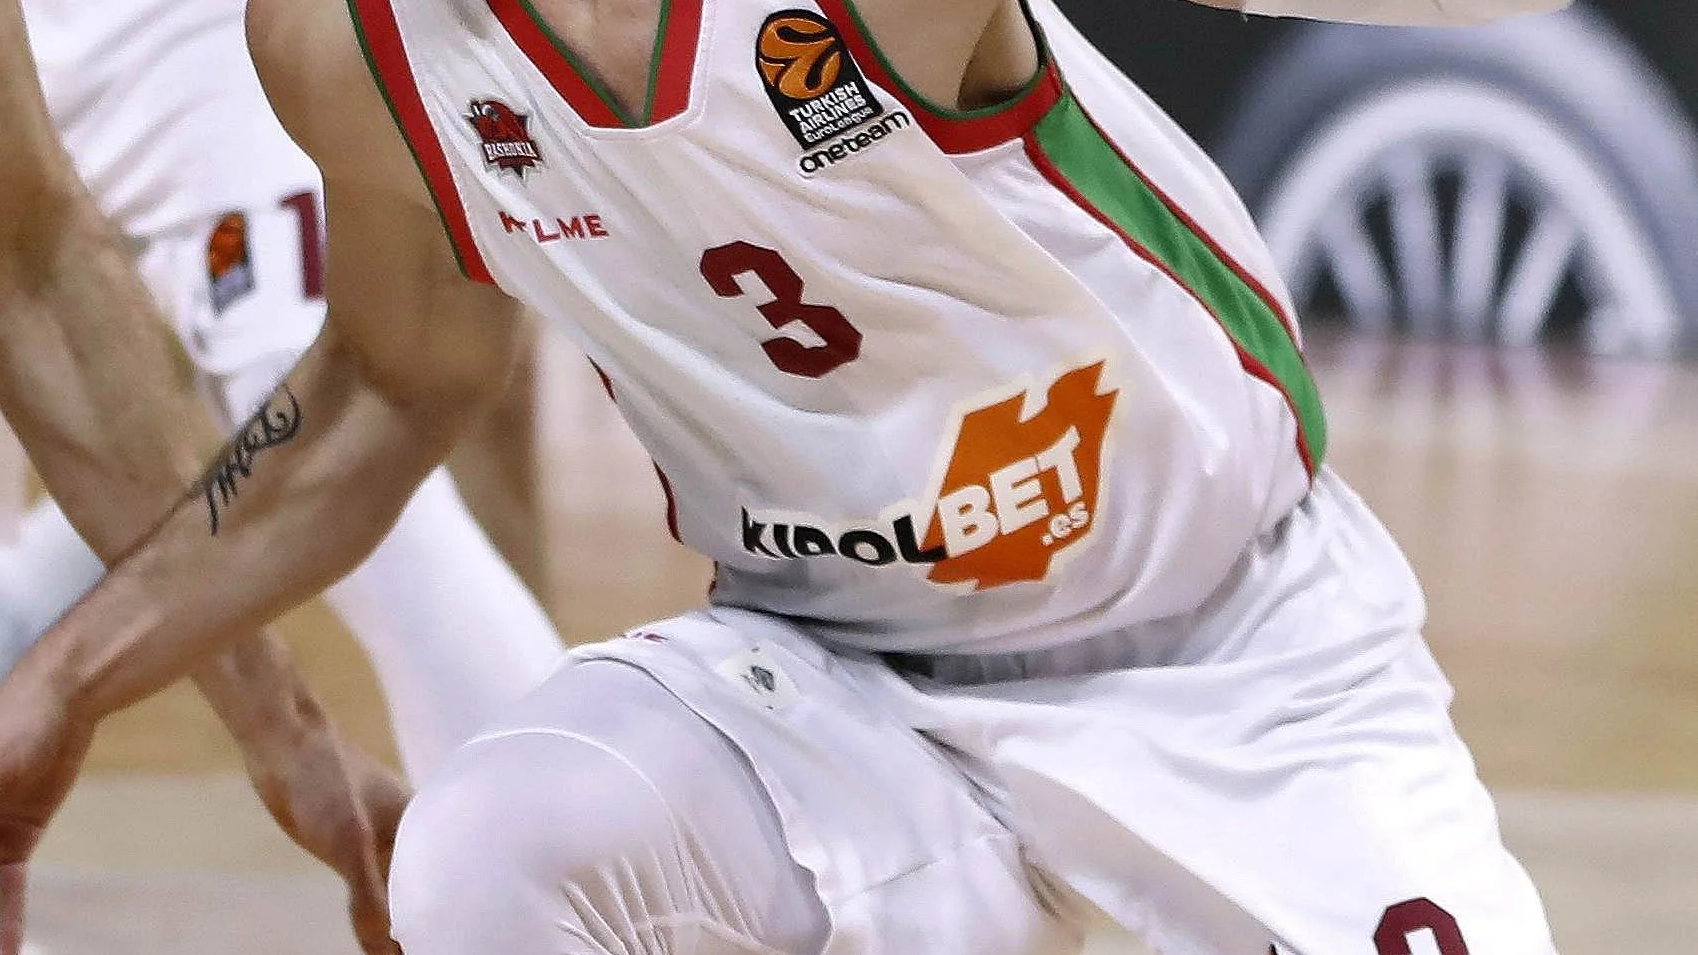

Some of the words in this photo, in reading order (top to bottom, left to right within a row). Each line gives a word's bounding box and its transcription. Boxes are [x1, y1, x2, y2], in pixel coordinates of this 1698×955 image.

[789, 82, 860, 123] TURKISH
[800, 95, 867, 134] AIRLINES
[800, 111, 910, 173] oneteam
[498, 209, 610, 243] KLME
[699, 240, 864, 379] 3
